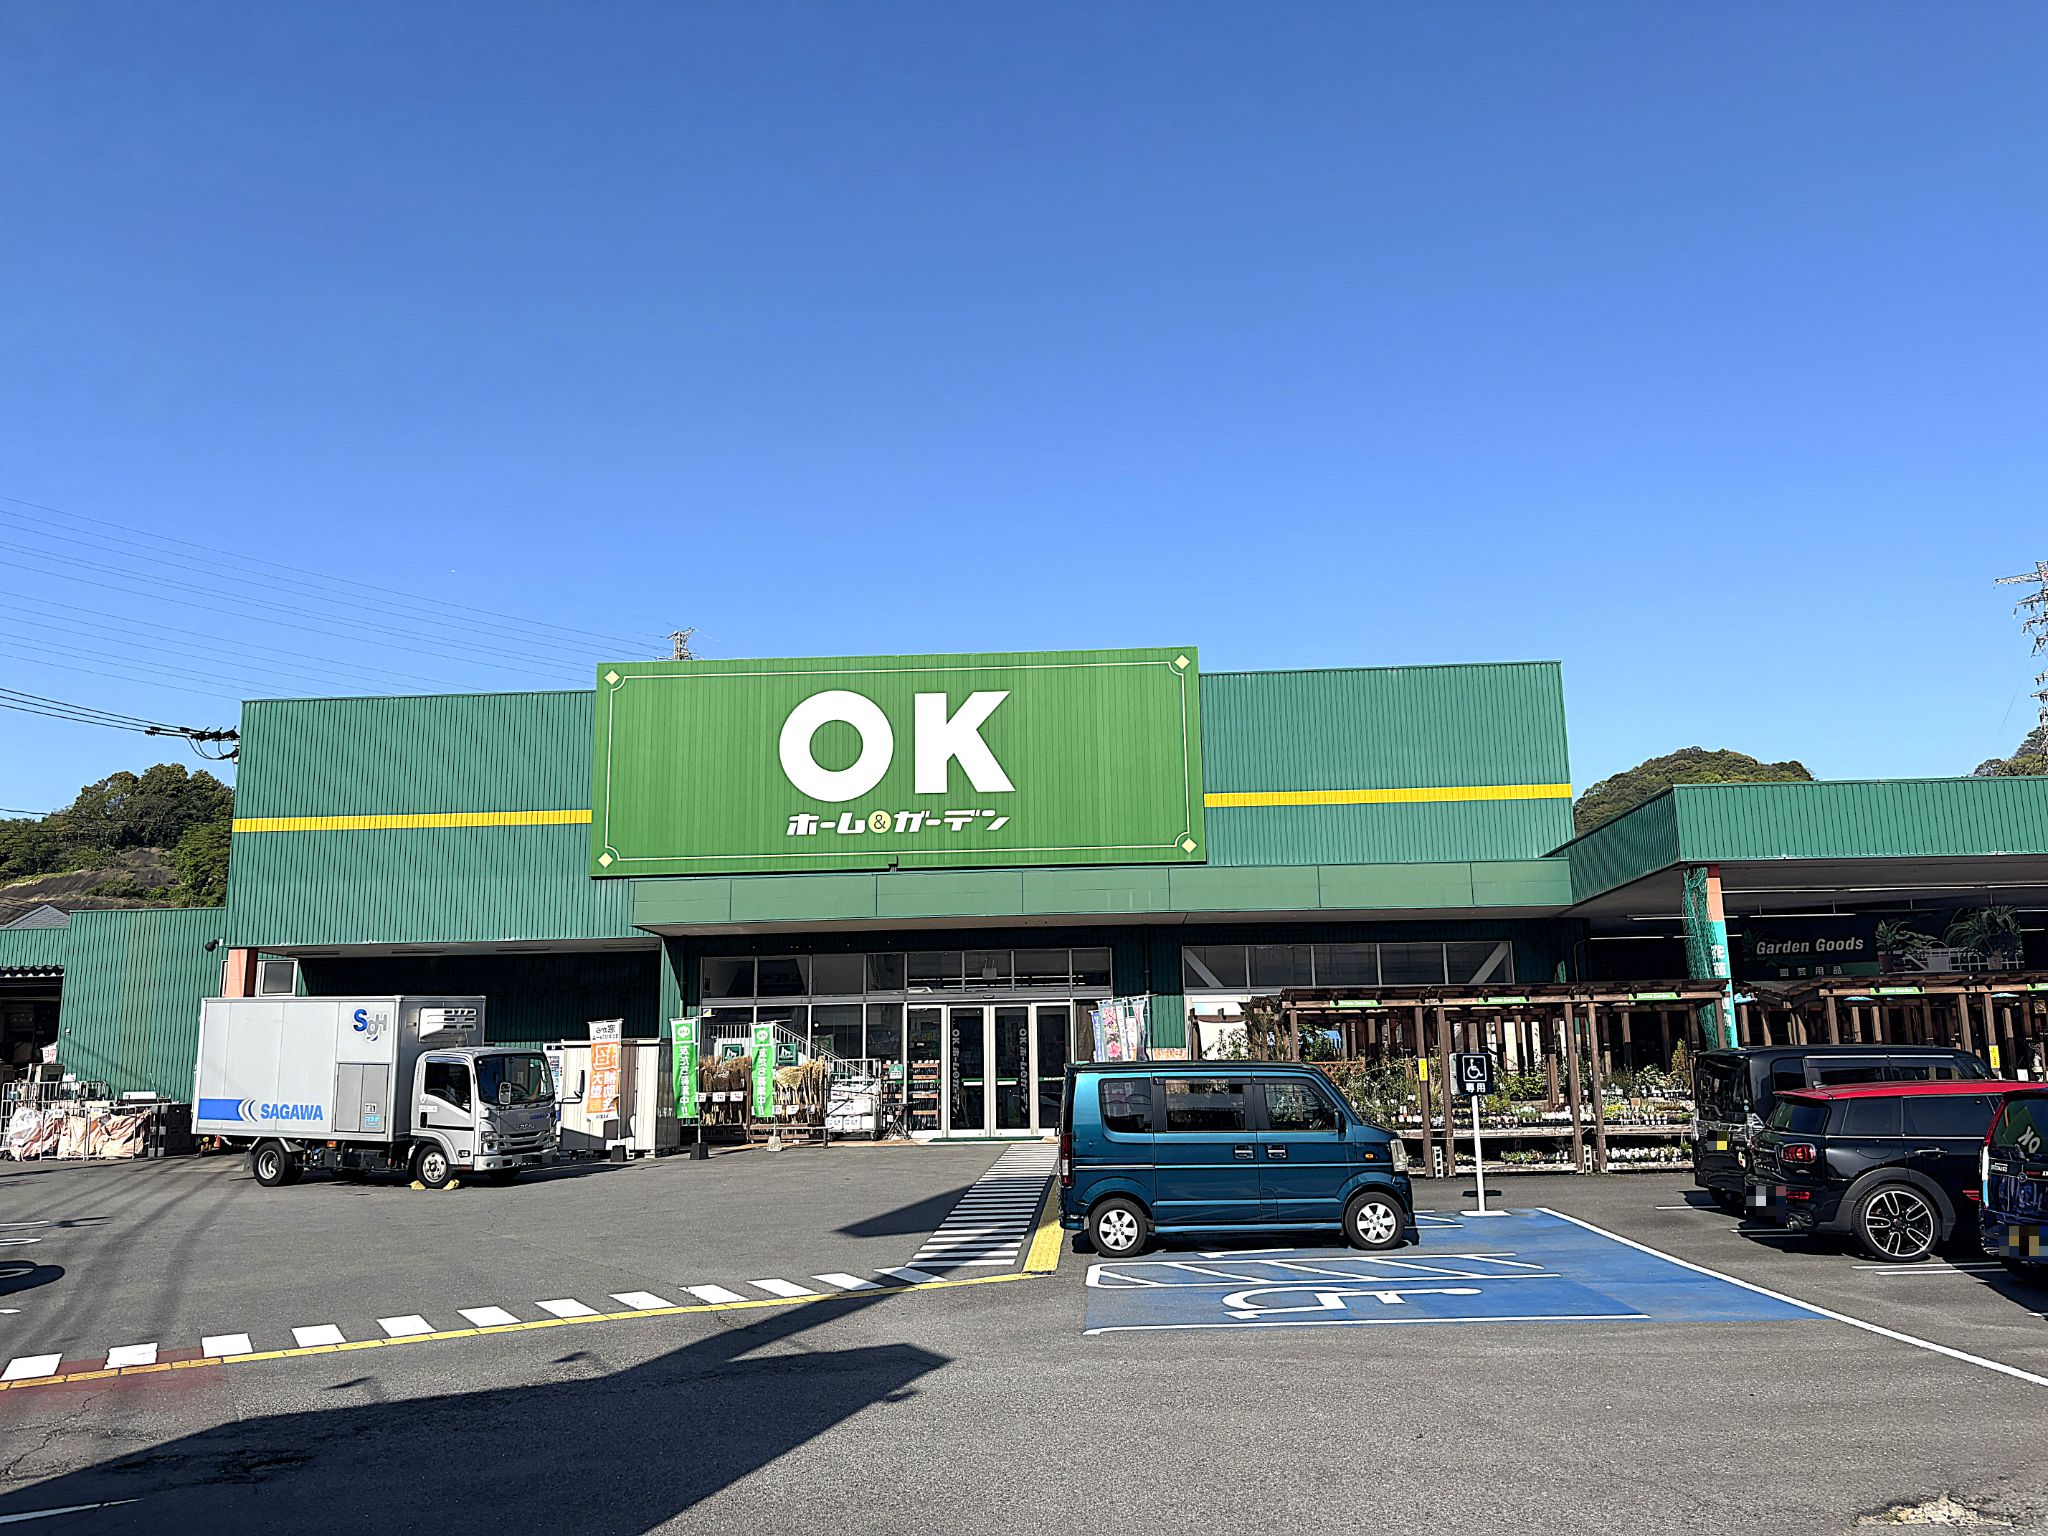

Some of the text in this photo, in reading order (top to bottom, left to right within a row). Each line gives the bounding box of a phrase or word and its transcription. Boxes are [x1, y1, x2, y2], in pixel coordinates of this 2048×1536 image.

[779, 689, 1016, 803] OK
[786, 809, 1011, 836] ホーム&ガーデン
[1756, 936, 1864, 955] Garden Goods
[260, 1103, 324, 1121] SAGAWA
